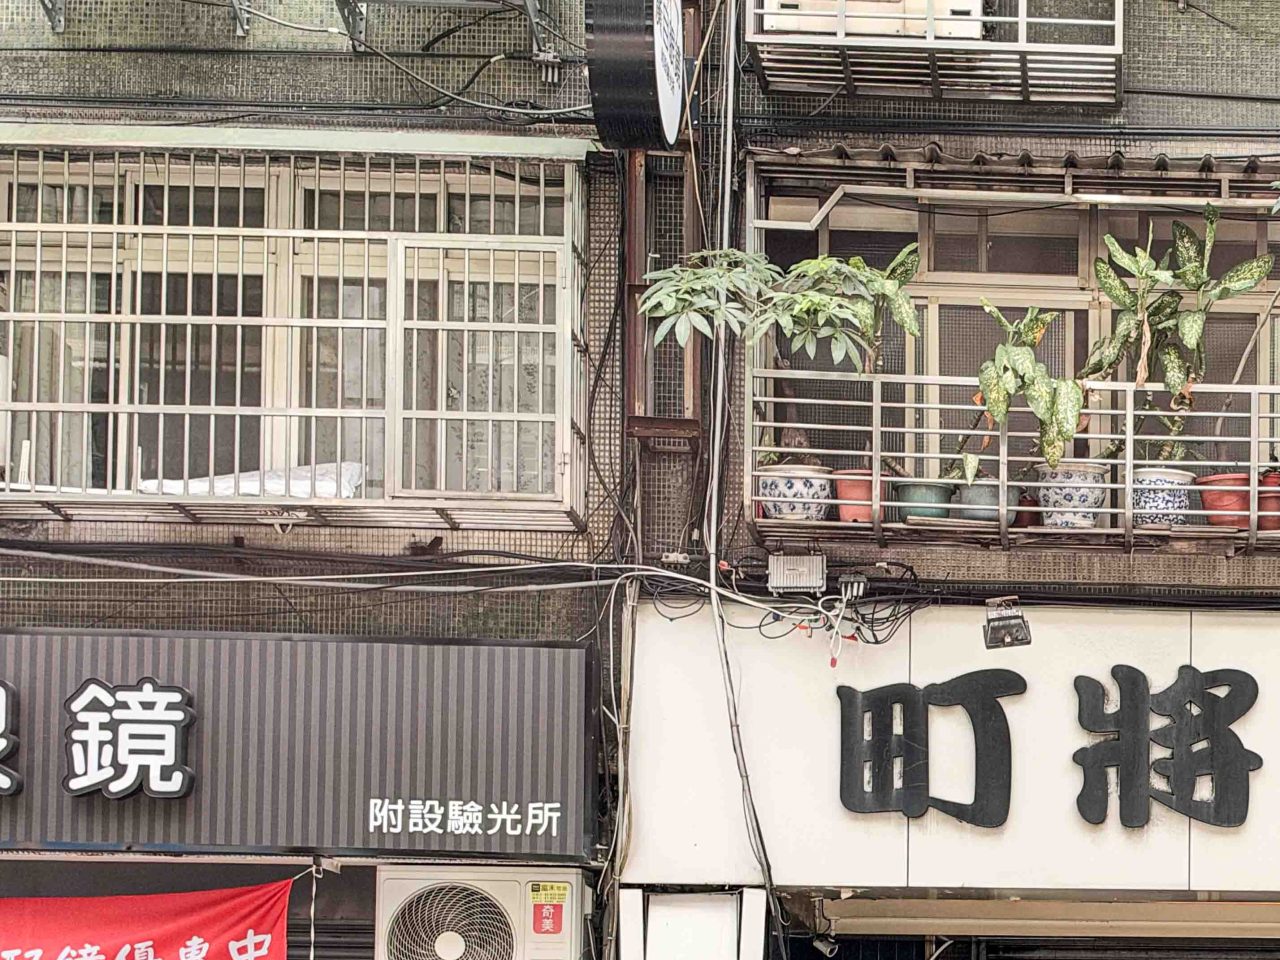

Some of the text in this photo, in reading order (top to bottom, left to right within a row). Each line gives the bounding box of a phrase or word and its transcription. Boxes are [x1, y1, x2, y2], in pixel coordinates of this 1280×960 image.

[0, 682, 185, 793] 鏡
[837, 662, 1264, 829] 町將
[369, 798, 561, 838] 附設驗光所
[541, 905, 555, 932] 奇美
